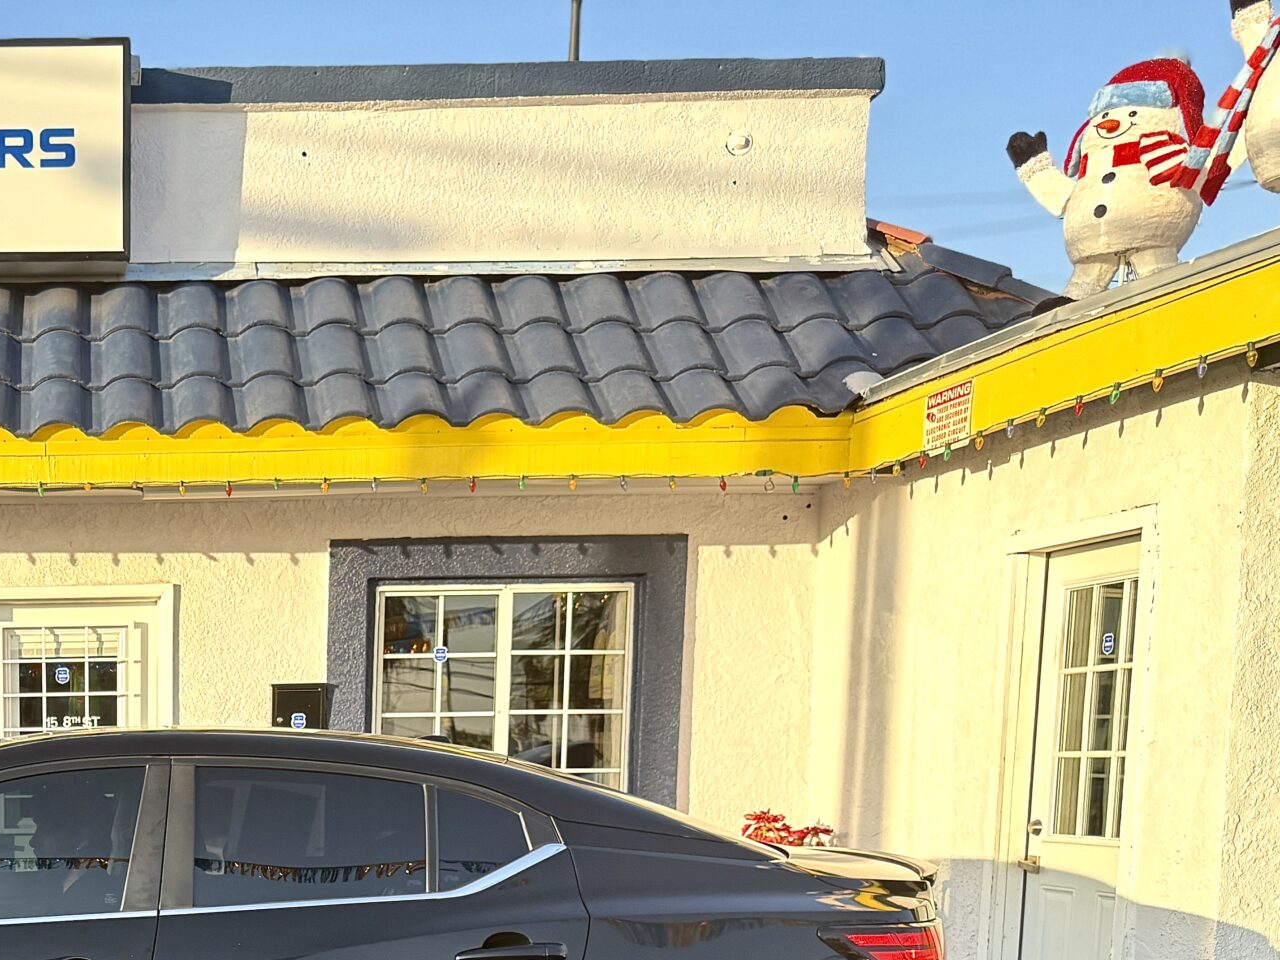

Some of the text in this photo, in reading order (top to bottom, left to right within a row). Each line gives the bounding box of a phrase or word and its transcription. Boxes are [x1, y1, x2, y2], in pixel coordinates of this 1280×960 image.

[928, 382, 971, 409] WARNING
[945, 409, 963, 421] SECURED
[82, 715, 101, 729] ST
